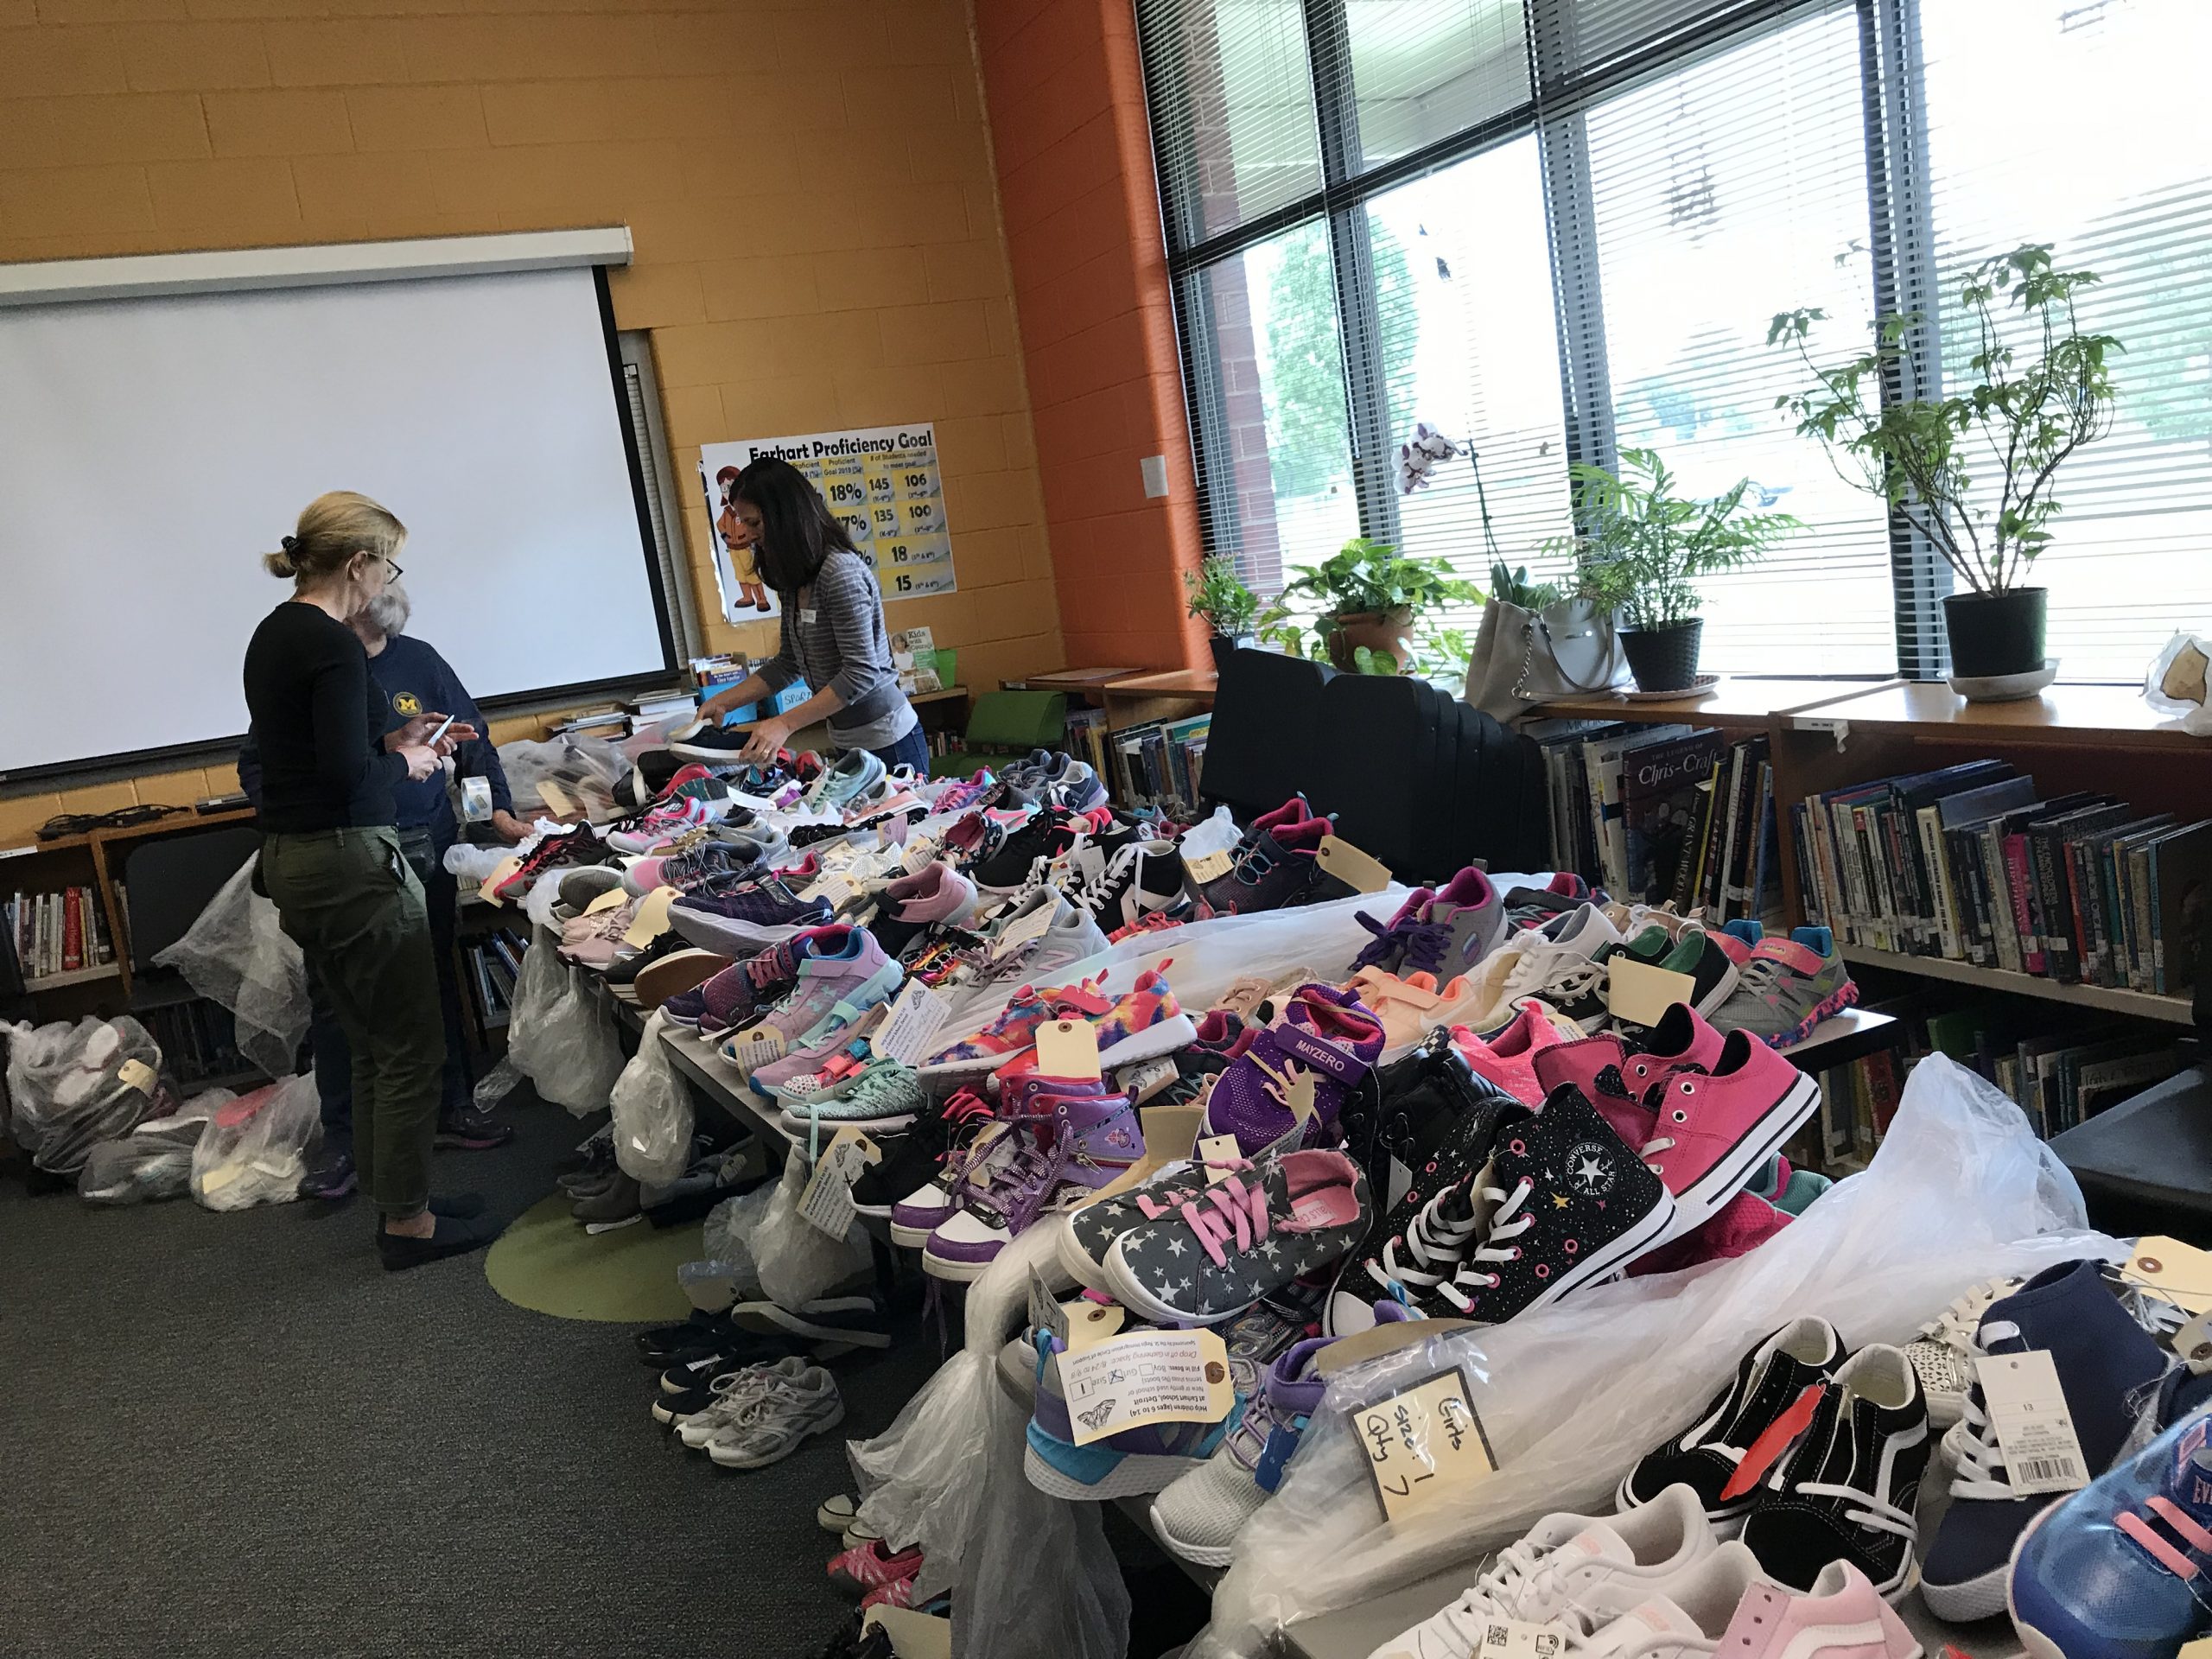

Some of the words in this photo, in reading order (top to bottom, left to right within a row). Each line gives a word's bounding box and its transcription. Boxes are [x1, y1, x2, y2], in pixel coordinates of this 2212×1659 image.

[749, 444, 809, 462] Earhart
[813, 438, 894, 456] Proficiency
[898, 430, 932, 447] Goal
[829, 457, 856, 466] Proficient
[869, 478, 890, 491] 145
[905, 474, 927, 487] 106
[830, 483, 862, 502] 18%
[874, 509, 894, 522] 135
[909, 504, 932, 517] 100
[891, 546, 908, 562] 18
[896, 575, 912, 591] 15
[400, 698, 417, 711] M
[1639, 749, 1717, 787] Chris-Craft
[1295, 1039, 1345, 1073] MAYZERO
[1567, 1144, 1603, 1175] CONVERSE
[1600, 1170, 1615, 1192] STAR
[1111, 1342, 1141, 1352] Immigration
[1072, 1355, 1091, 1366] Support
[1133, 1352, 1163, 1361] Gathering
[1179, 1351, 1197, 1359] Drop
[1123, 1368, 1137, 1378] Girl
[1092, 1376, 1107, 1387] Size
[1134, 1396, 1157, 1405] Detroit
[2023, 1403, 2034, 1411] 13
